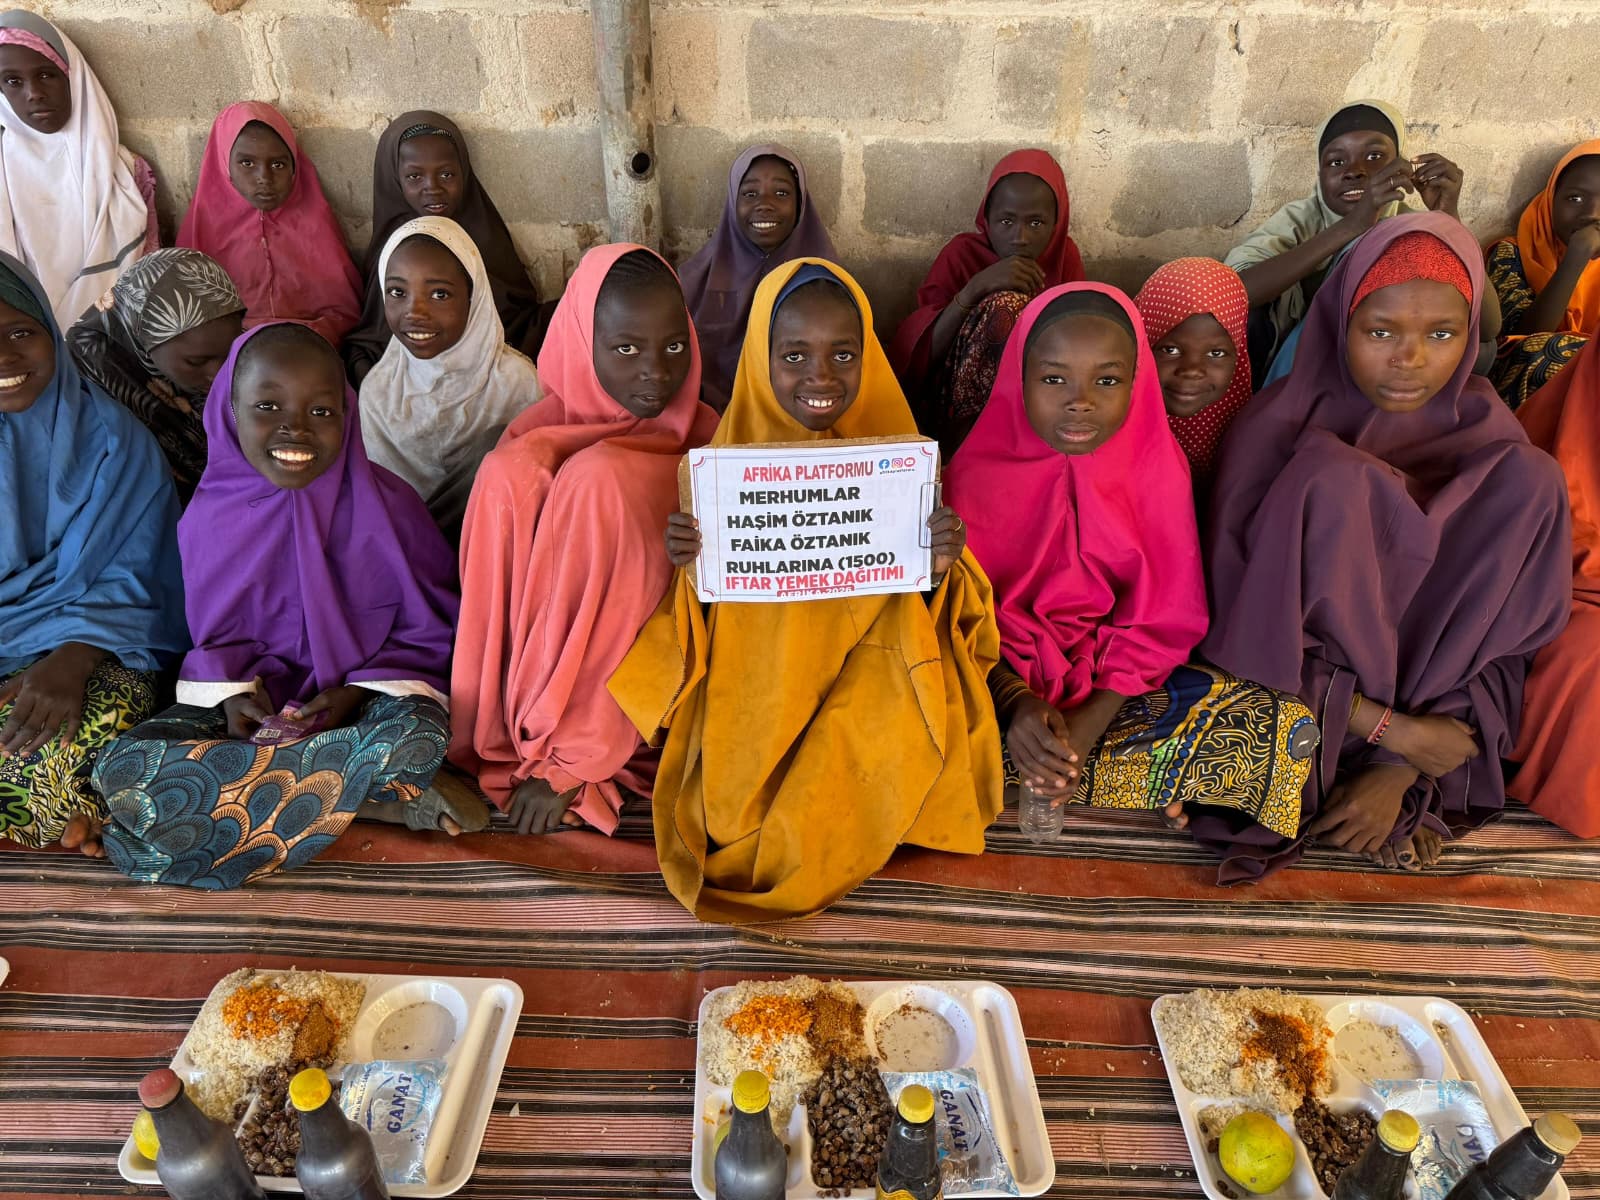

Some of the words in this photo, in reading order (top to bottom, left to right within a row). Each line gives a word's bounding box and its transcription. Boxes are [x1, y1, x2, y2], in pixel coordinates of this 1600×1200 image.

[743, 463, 792, 482] AFRİKA
[795, 460, 874, 481] PLATFORMU
[739, 486, 860, 504] MERHUMLAR
[727, 511, 788, 530] HAŞİM
[792, 508, 873, 527] ÖZTANIK
[731, 534, 786, 552] FAİKA
[790, 531, 871, 550] ÖZTANIK
[726, 557, 834, 574] RUHLARINA
[838, 551, 896, 571] (1500)
[725, 575, 772, 590] IFTAR
[775, 572, 831, 589] YEMEK
[834, 565, 904, 586] DAĞITIMI
[386, 1073, 413, 1134] GANAT
[939, 1089, 969, 1152] GANAT
